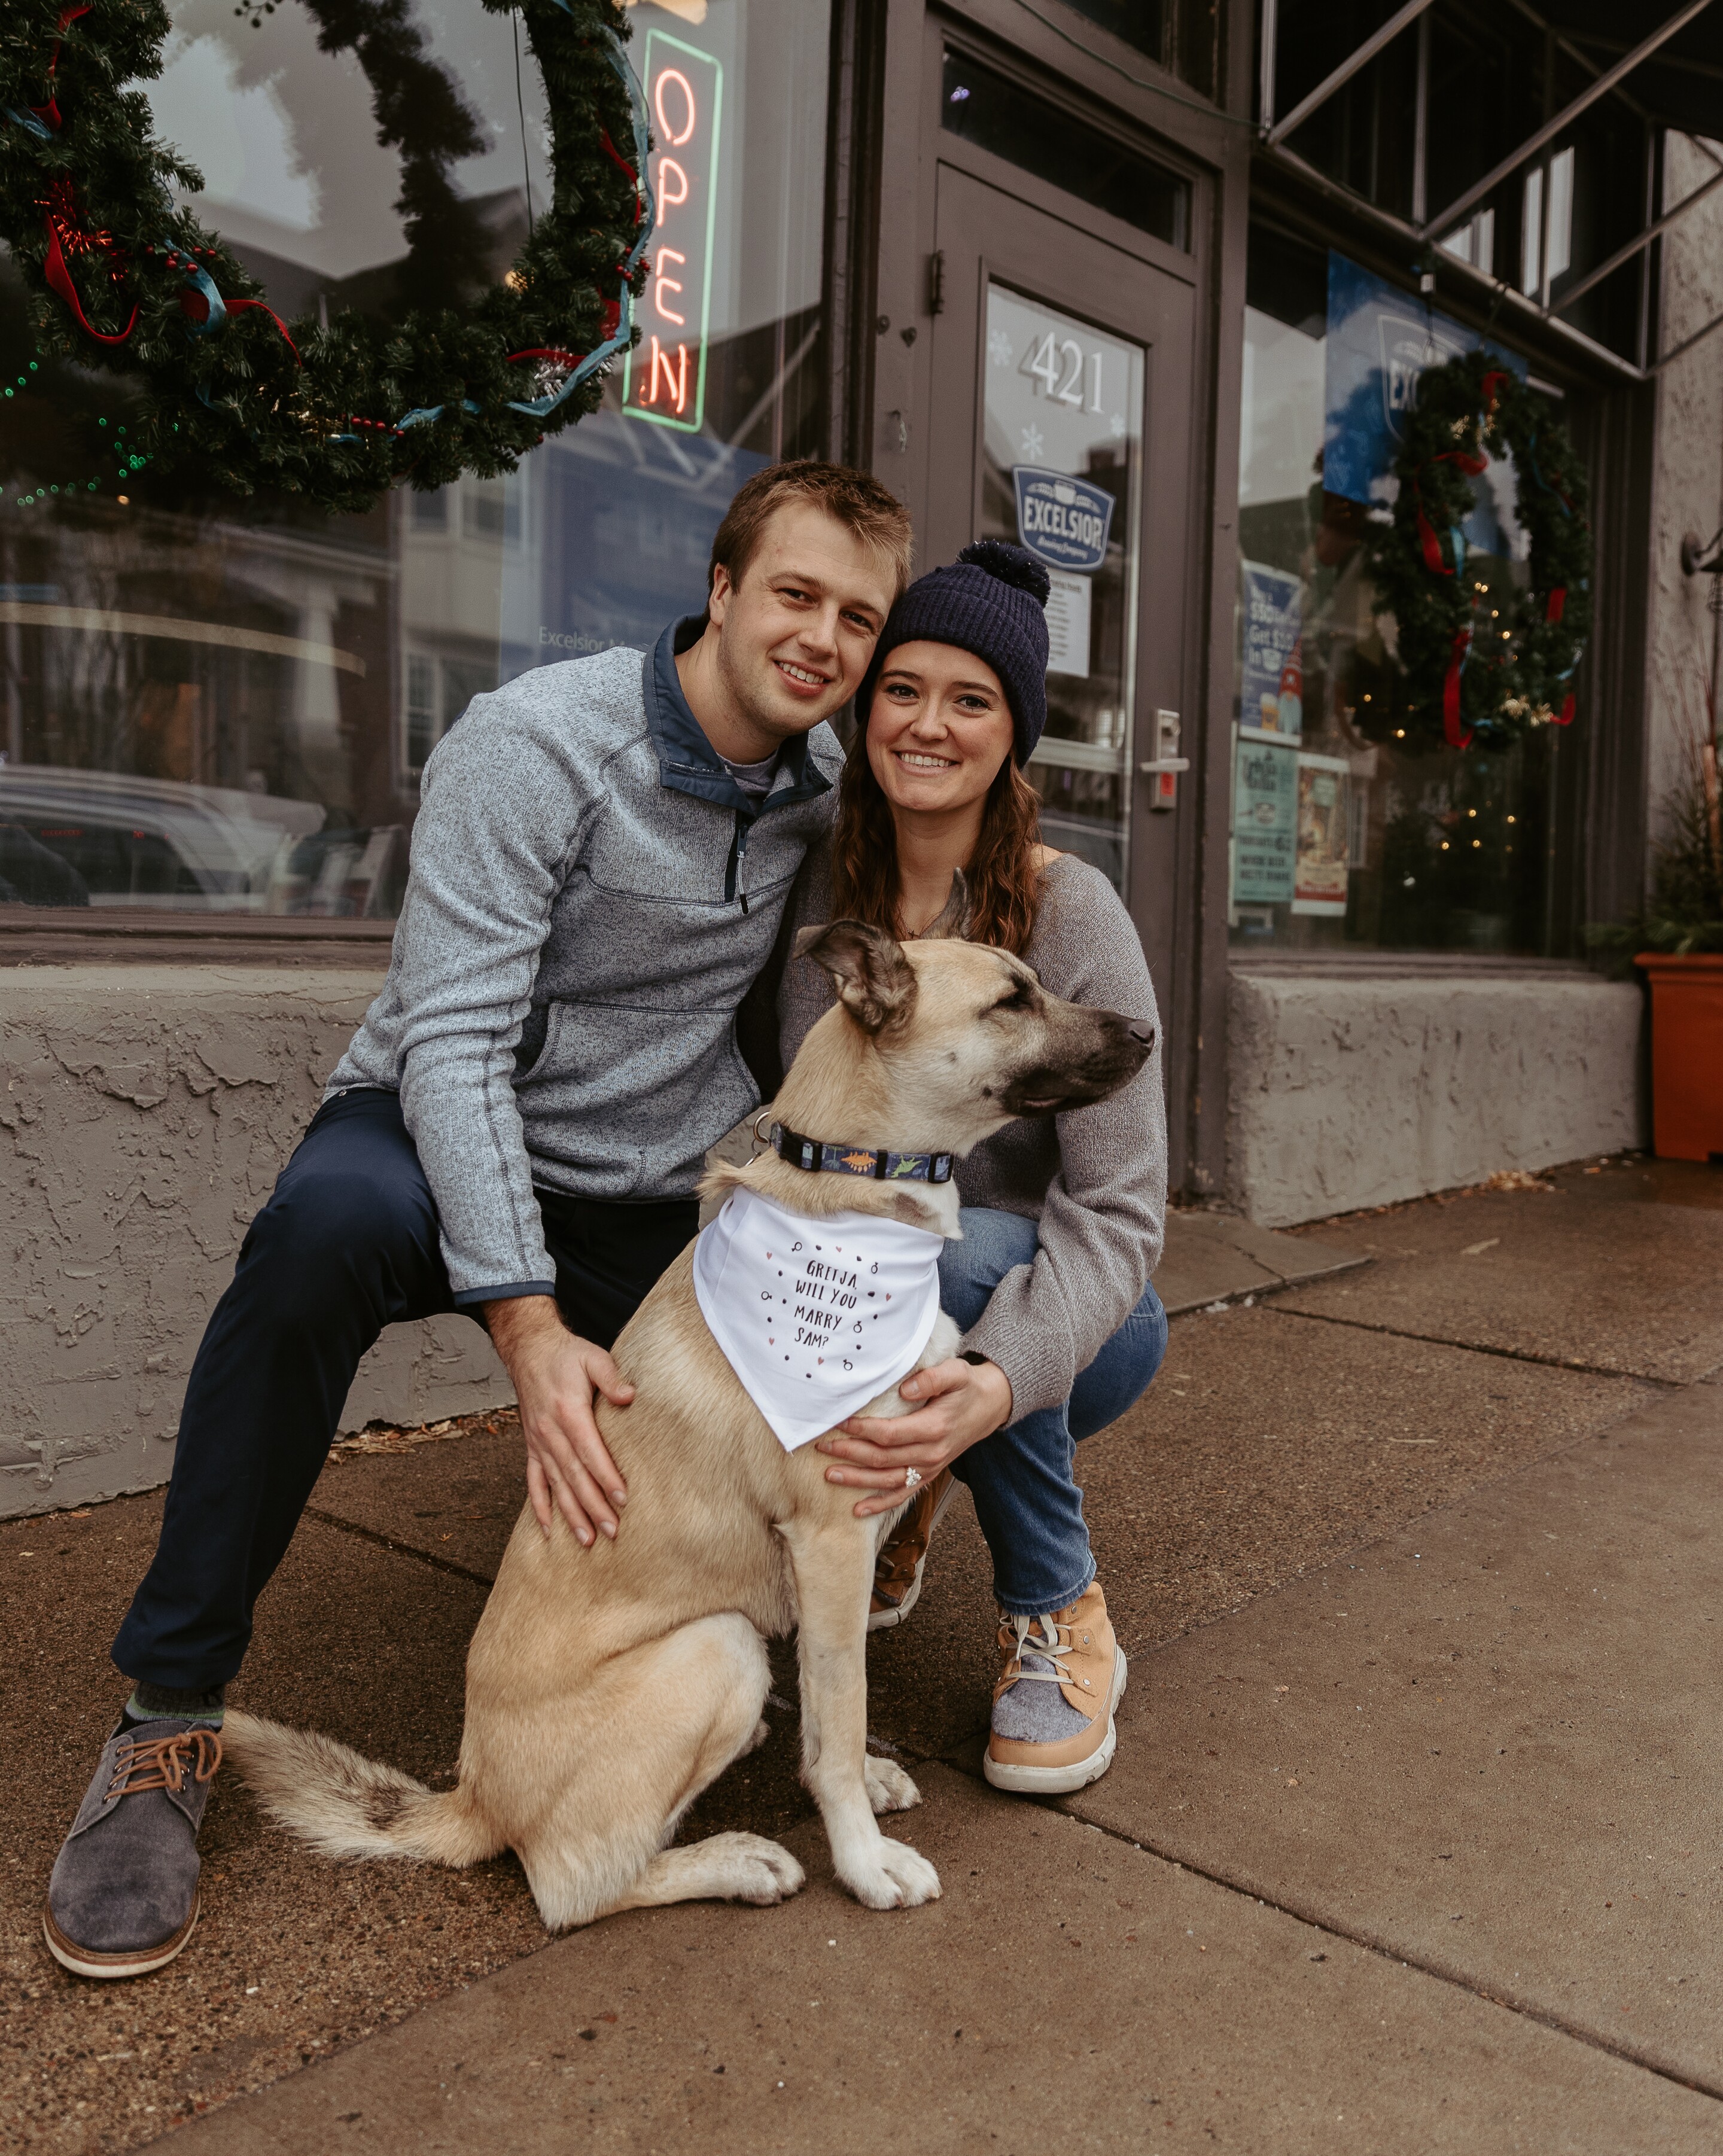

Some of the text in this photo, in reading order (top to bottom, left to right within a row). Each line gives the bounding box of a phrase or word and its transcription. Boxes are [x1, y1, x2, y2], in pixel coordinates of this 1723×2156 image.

[650, 68, 696, 415] OPEN
[1030, 331, 1105, 414] 421
[1024, 495, 1103, 551] EXCELSIOR
[540, 626, 605, 653] Excelsior
[806, 1259, 857, 1290] GRETJA,
[796, 1280, 857, 1309] WILL YOU
[794, 1305, 842, 1330] MARRY
[794, 1327, 829, 1349] SAM?
